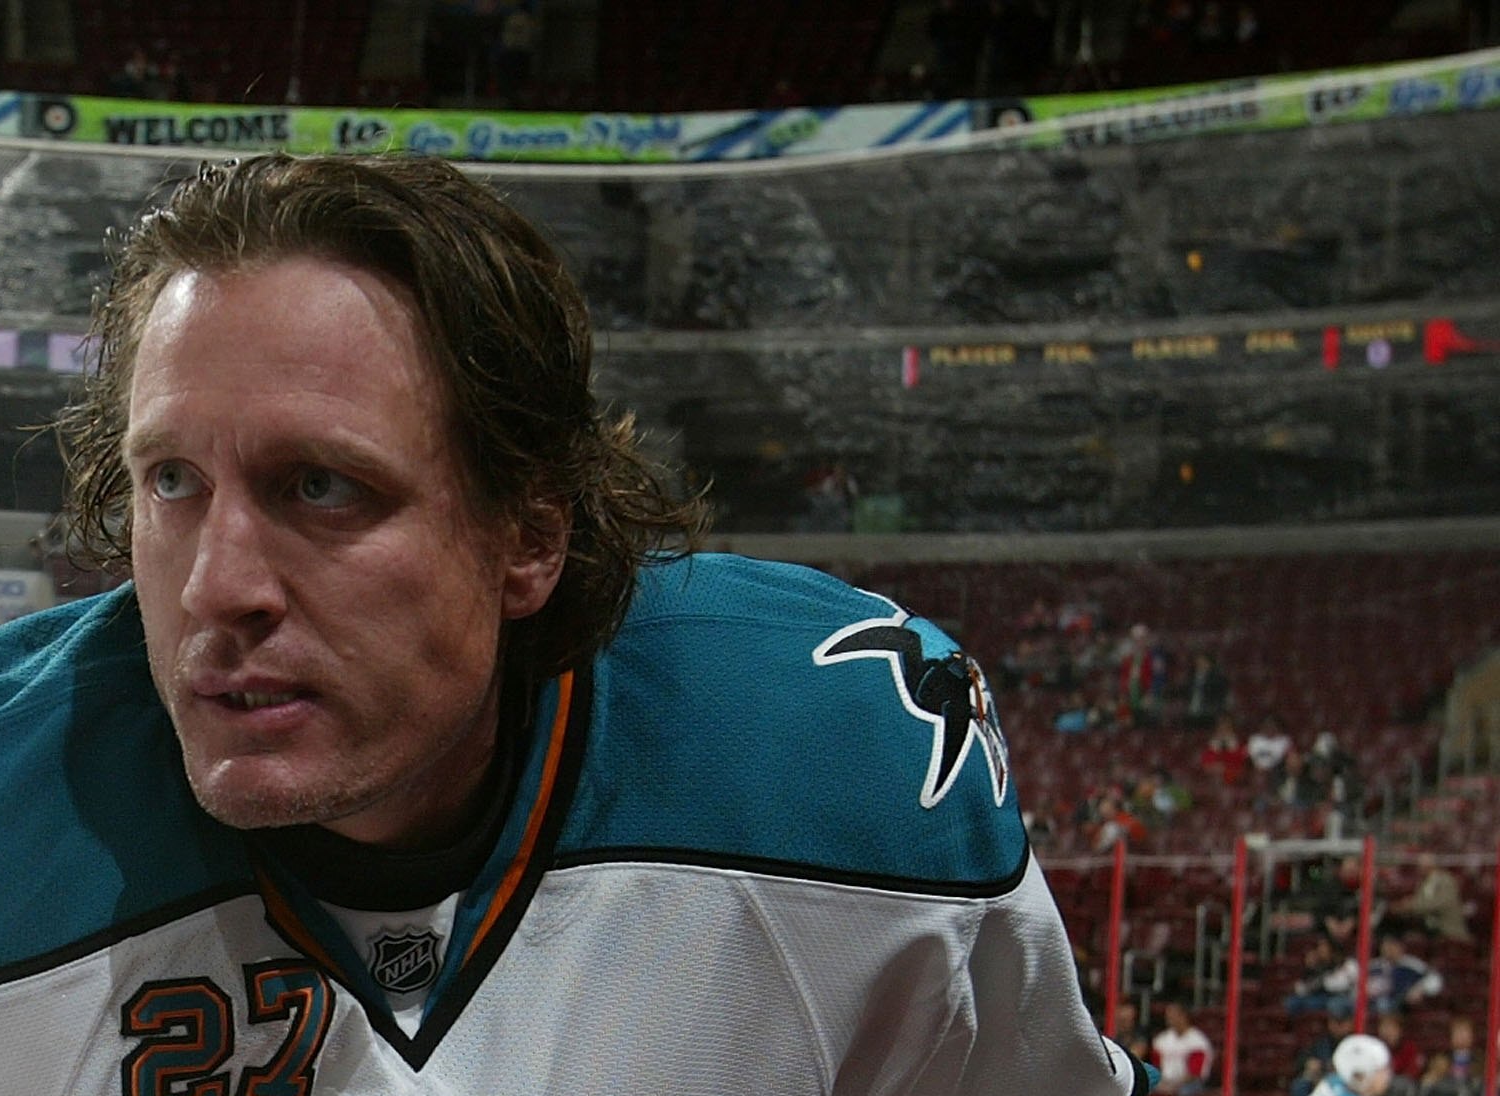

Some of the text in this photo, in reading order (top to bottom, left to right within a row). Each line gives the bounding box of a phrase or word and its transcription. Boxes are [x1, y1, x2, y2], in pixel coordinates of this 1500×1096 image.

[106, 113, 290, 145] WELCOME
[340, 117, 382, 148] to
[408, 121, 454, 153] Go
[384, 942, 430, 984] NHL
